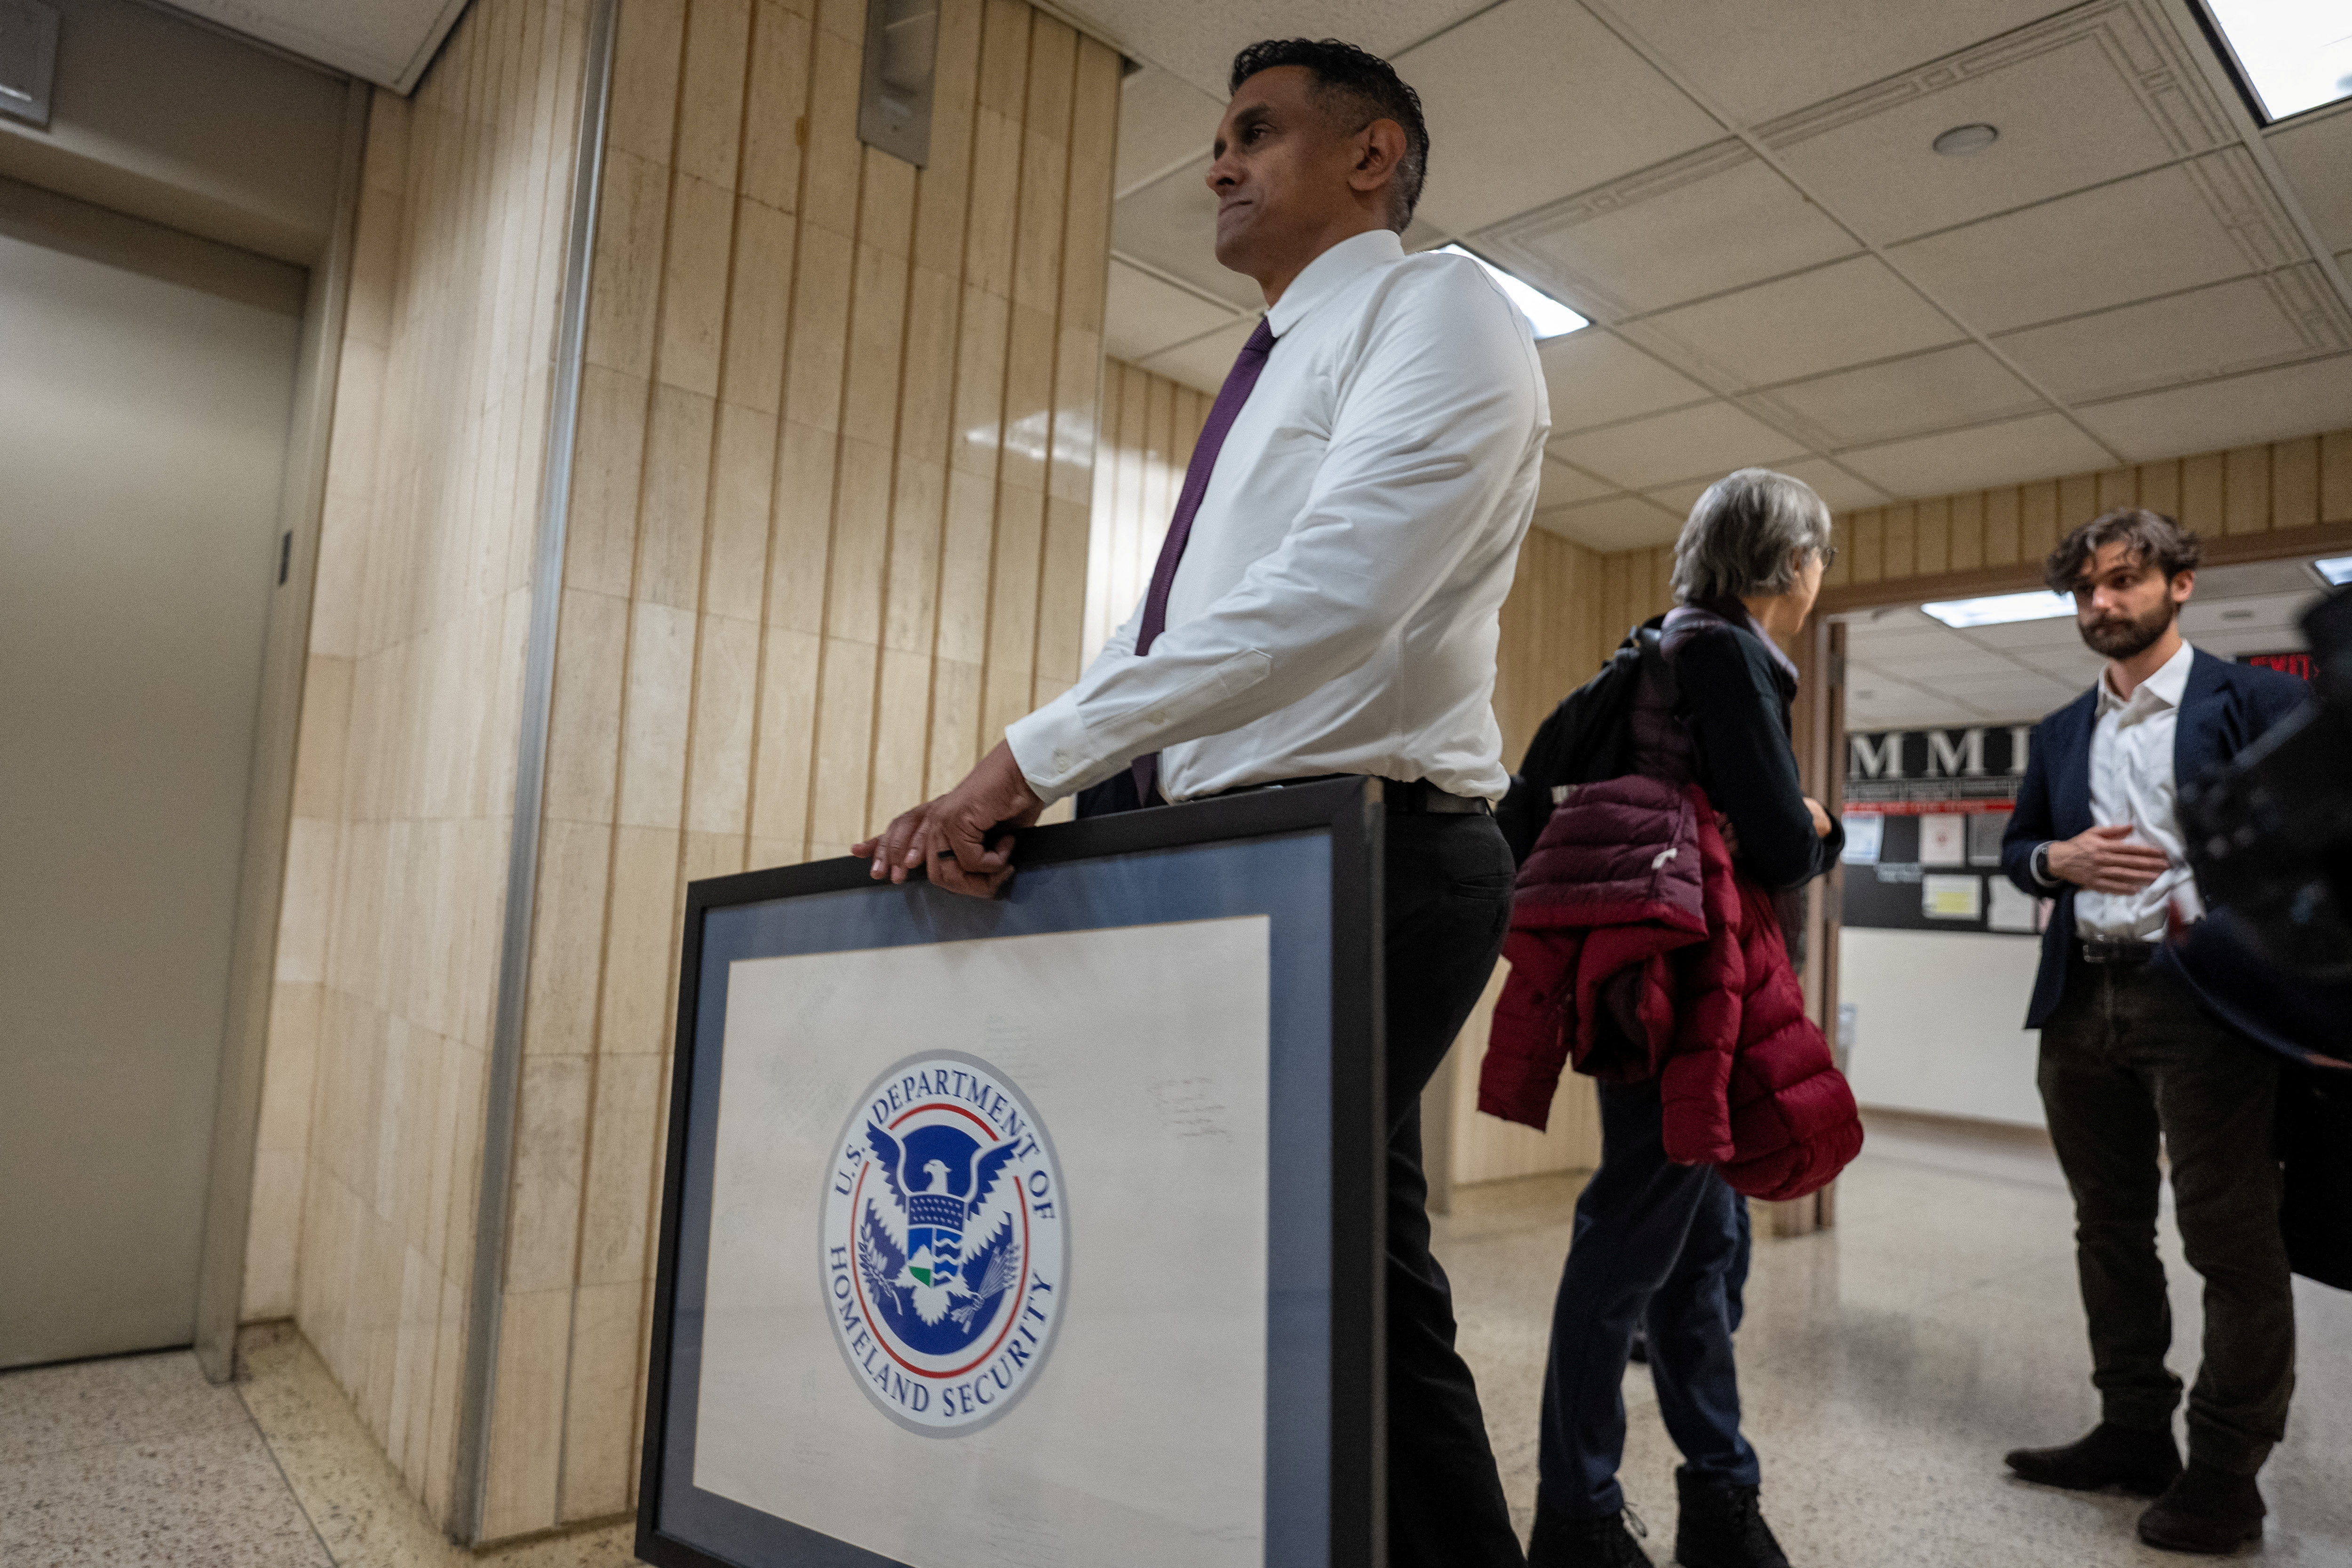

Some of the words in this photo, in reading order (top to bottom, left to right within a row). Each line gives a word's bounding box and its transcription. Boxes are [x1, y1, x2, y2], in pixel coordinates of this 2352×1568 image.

[834, 1143, 866, 1196] U.S.
[872, 1068, 1041, 1162] DEPARTMENT
[1028, 1170, 1056, 1220] OF
[830, 1243, 930, 1413] HOMELAND
[943, 1268, 1053, 1417] SECURITY
